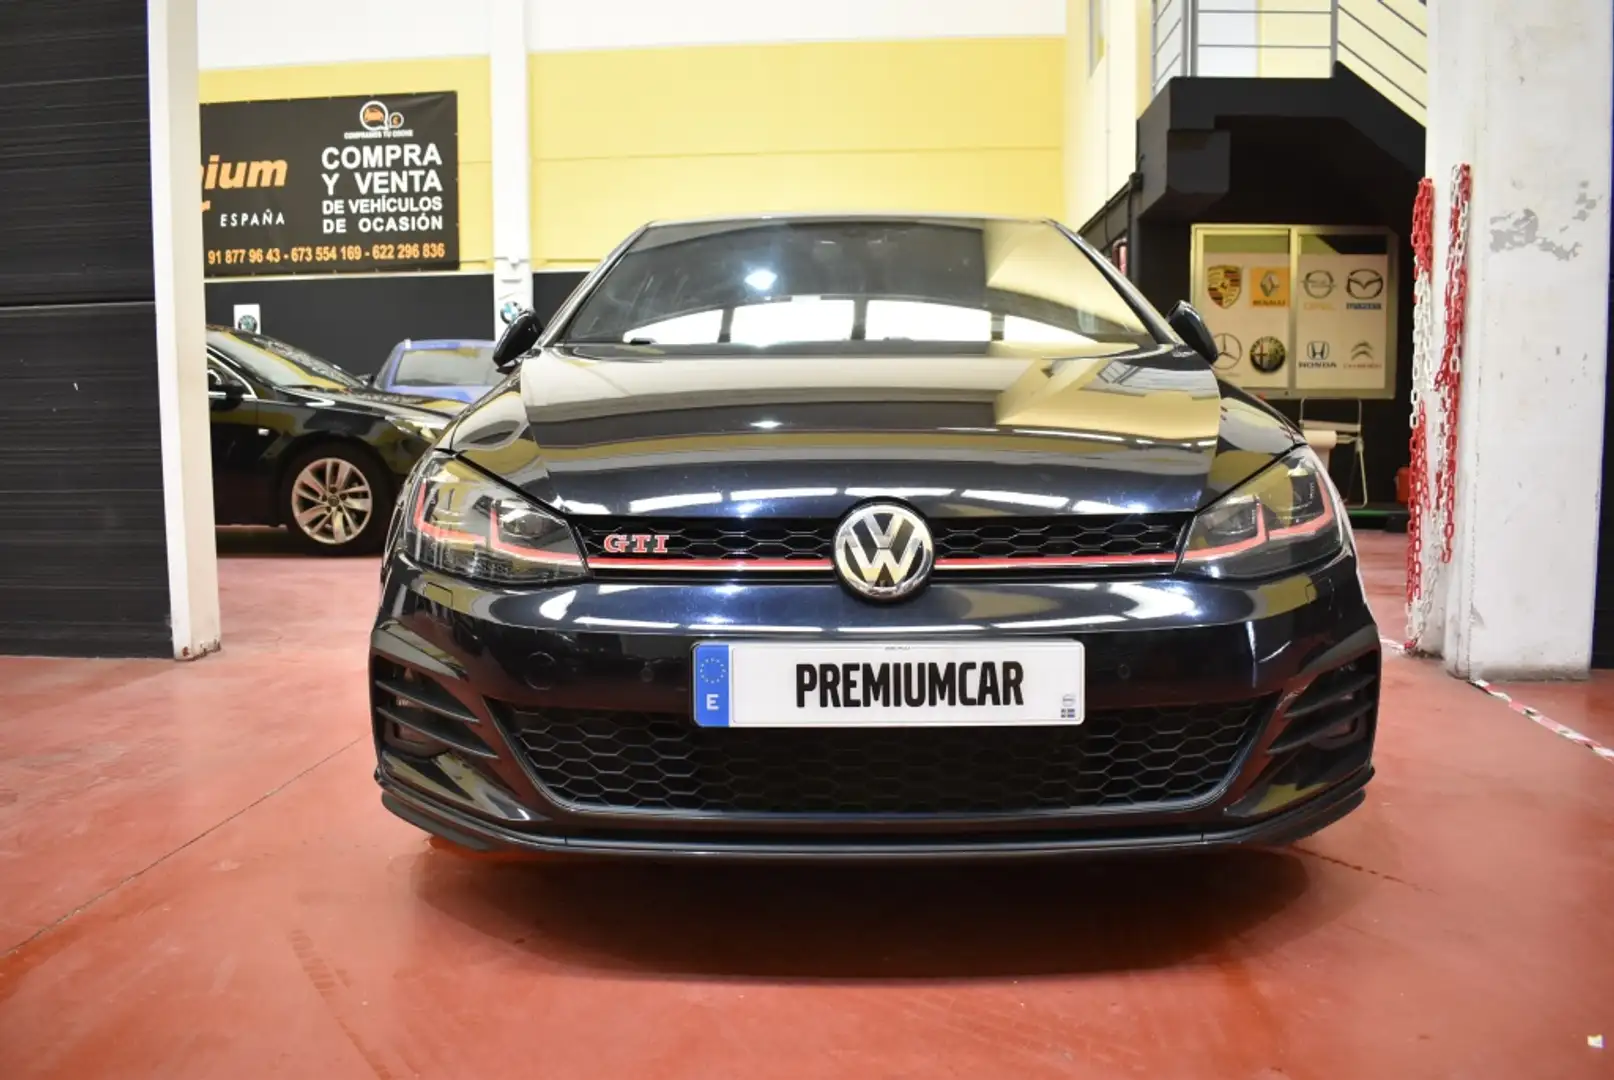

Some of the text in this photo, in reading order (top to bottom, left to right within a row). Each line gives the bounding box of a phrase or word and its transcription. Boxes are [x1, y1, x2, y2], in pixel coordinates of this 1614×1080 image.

[321, 142, 442, 170] COMPRA
[202, 154, 288, 190] ium
[321, 169, 443, 196] Y VENTA
[322, 194, 443, 215] DE VEHÍCULOS
[220, 208, 285, 228] ESPAÑA
[323, 212, 443, 234] DE OCASIÓN
[207, 249, 221, 265] 91
[225, 248, 246, 264] 877
[248, 248, 263, 264] 96
[266, 247, 281, 263] 43
[291, 246, 313, 263] 673
[315, 245, 337, 262] 554
[340, 244, 362, 261] 169
[372, 243, 395, 260] 622
[397, 243, 420, 259] 296
[422, 242, 445, 258] 836
[1298, 361, 1337, 369] HONDA
[603, 534, 670, 553] GTI
[795, 660, 1024, 709] PREMIUMCAR
[706, 693, 719, 711] E
